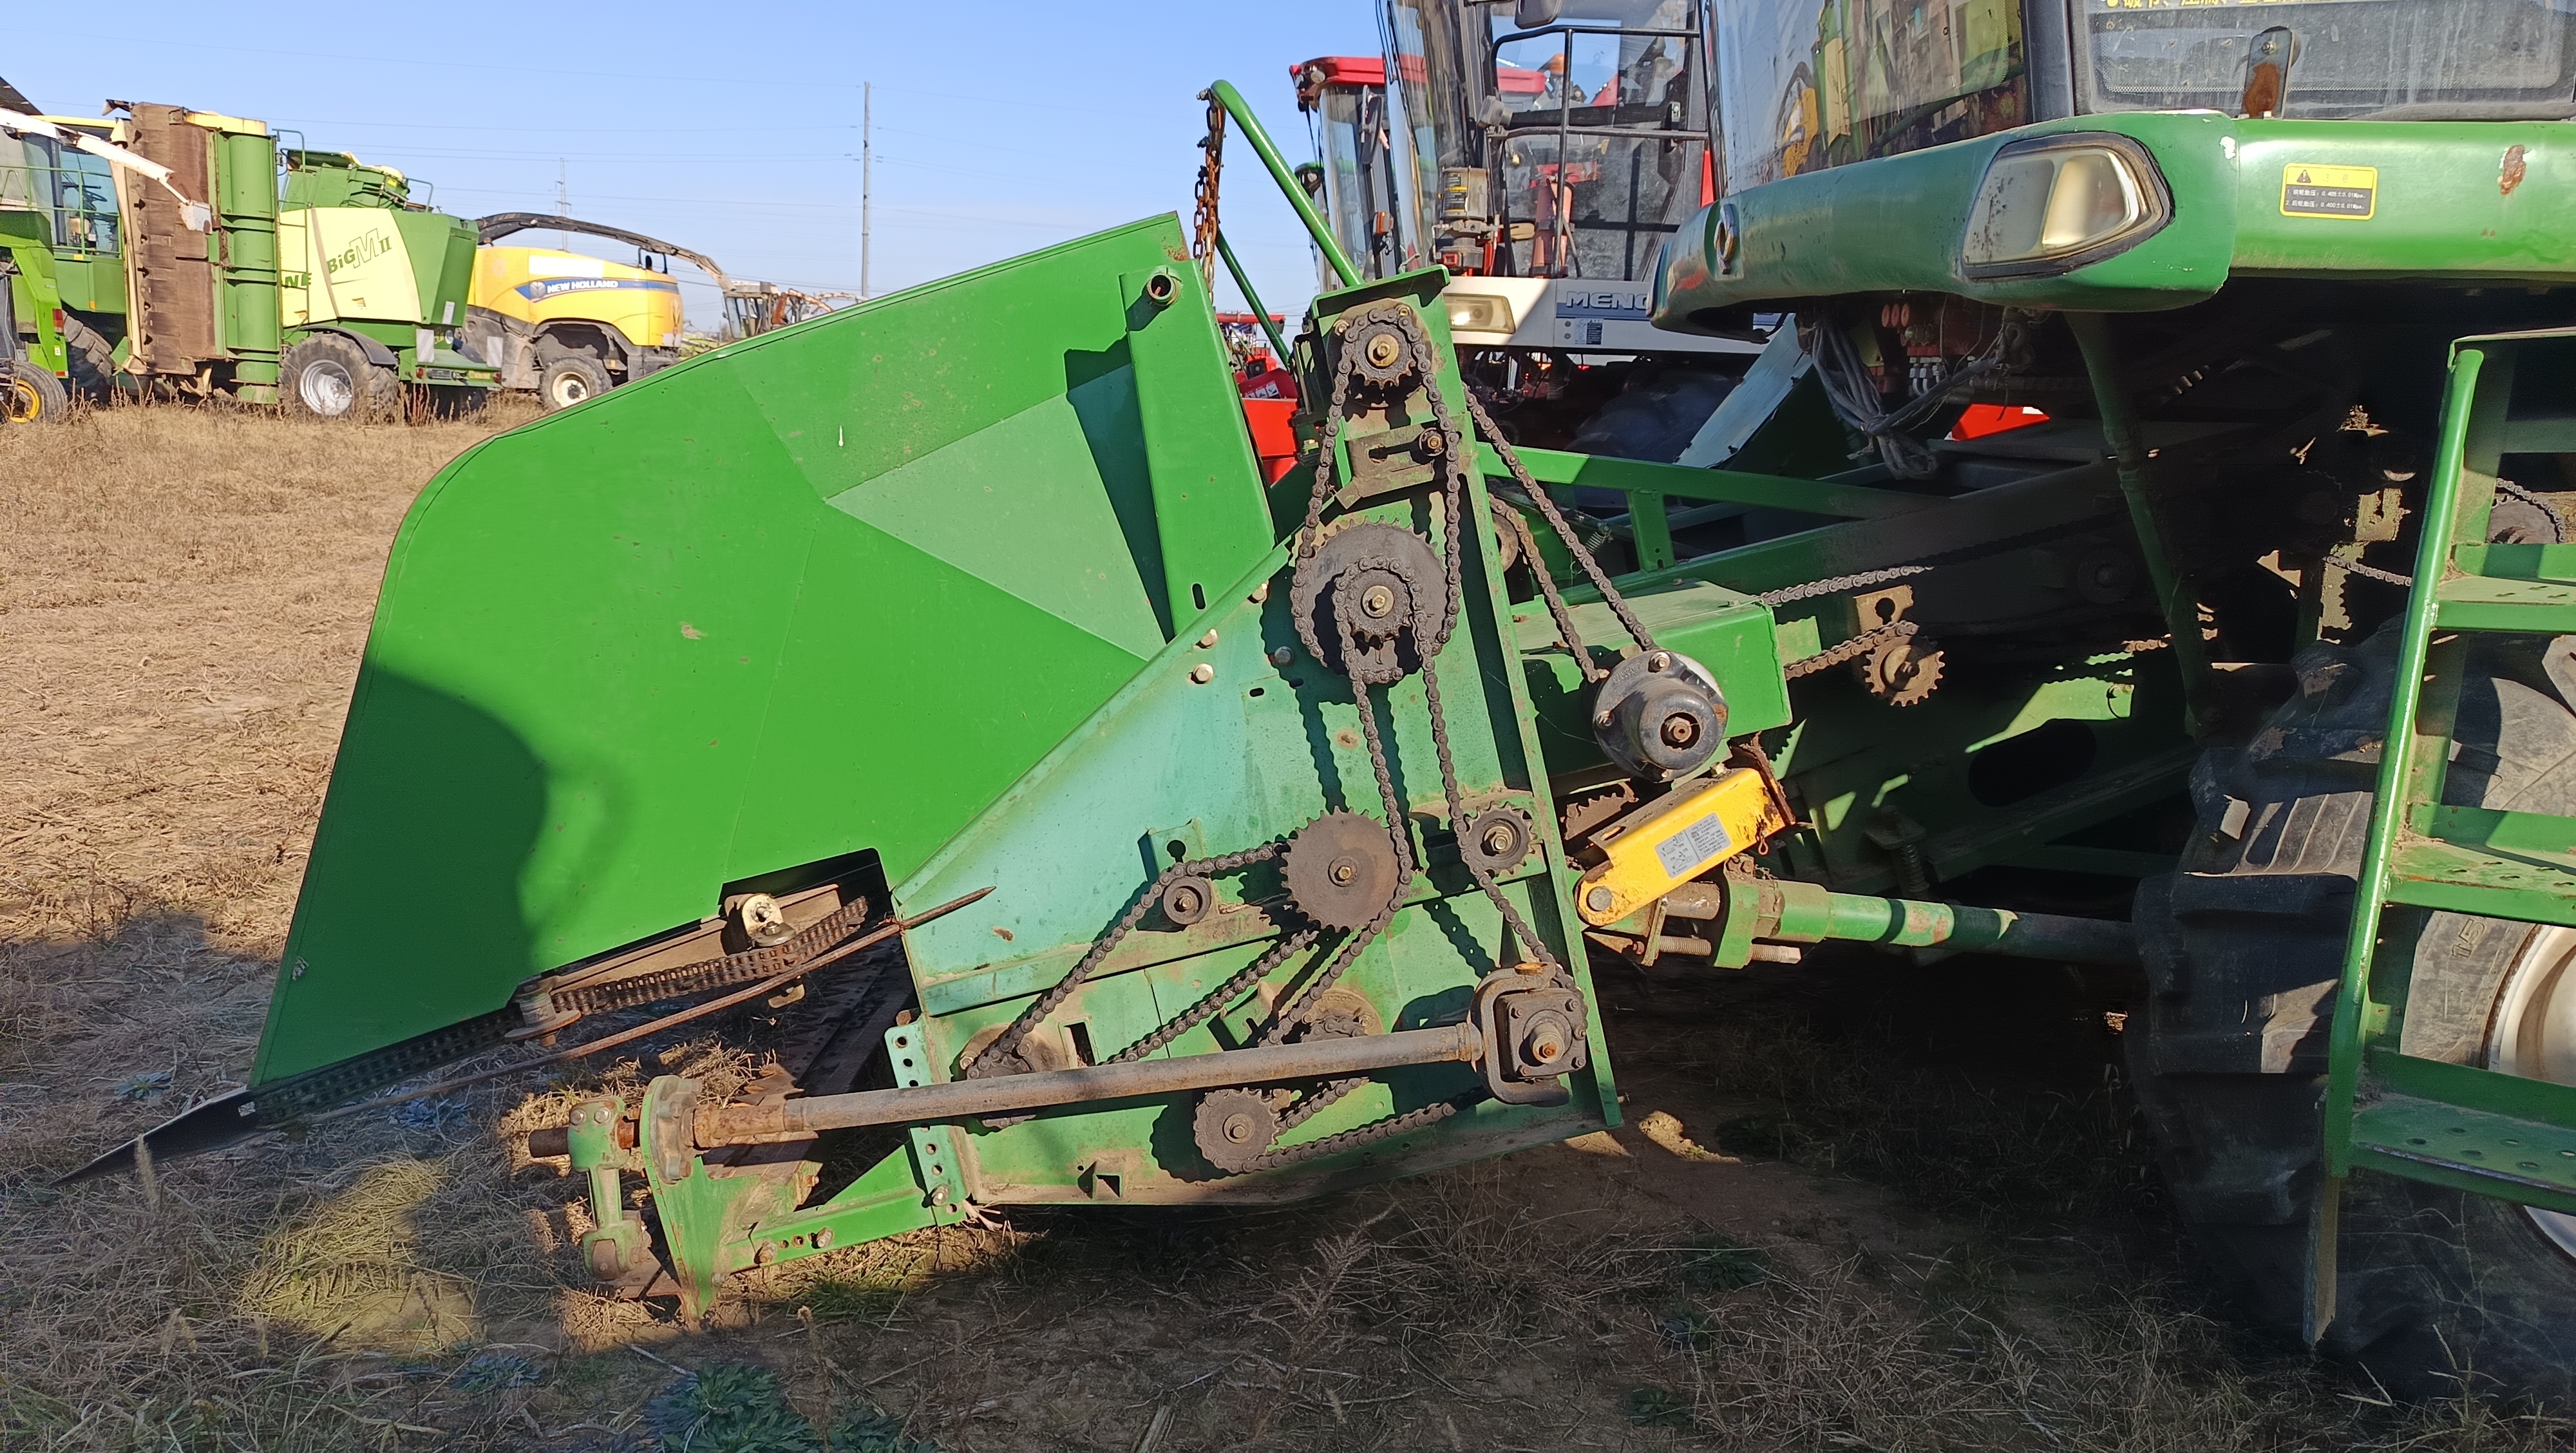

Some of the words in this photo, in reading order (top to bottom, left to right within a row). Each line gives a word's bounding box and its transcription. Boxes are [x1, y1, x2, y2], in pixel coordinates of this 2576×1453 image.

[285, 272, 312, 287] NE
[547, 281, 569, 293] NEW
[571, 280, 618, 290] HOLLAND
